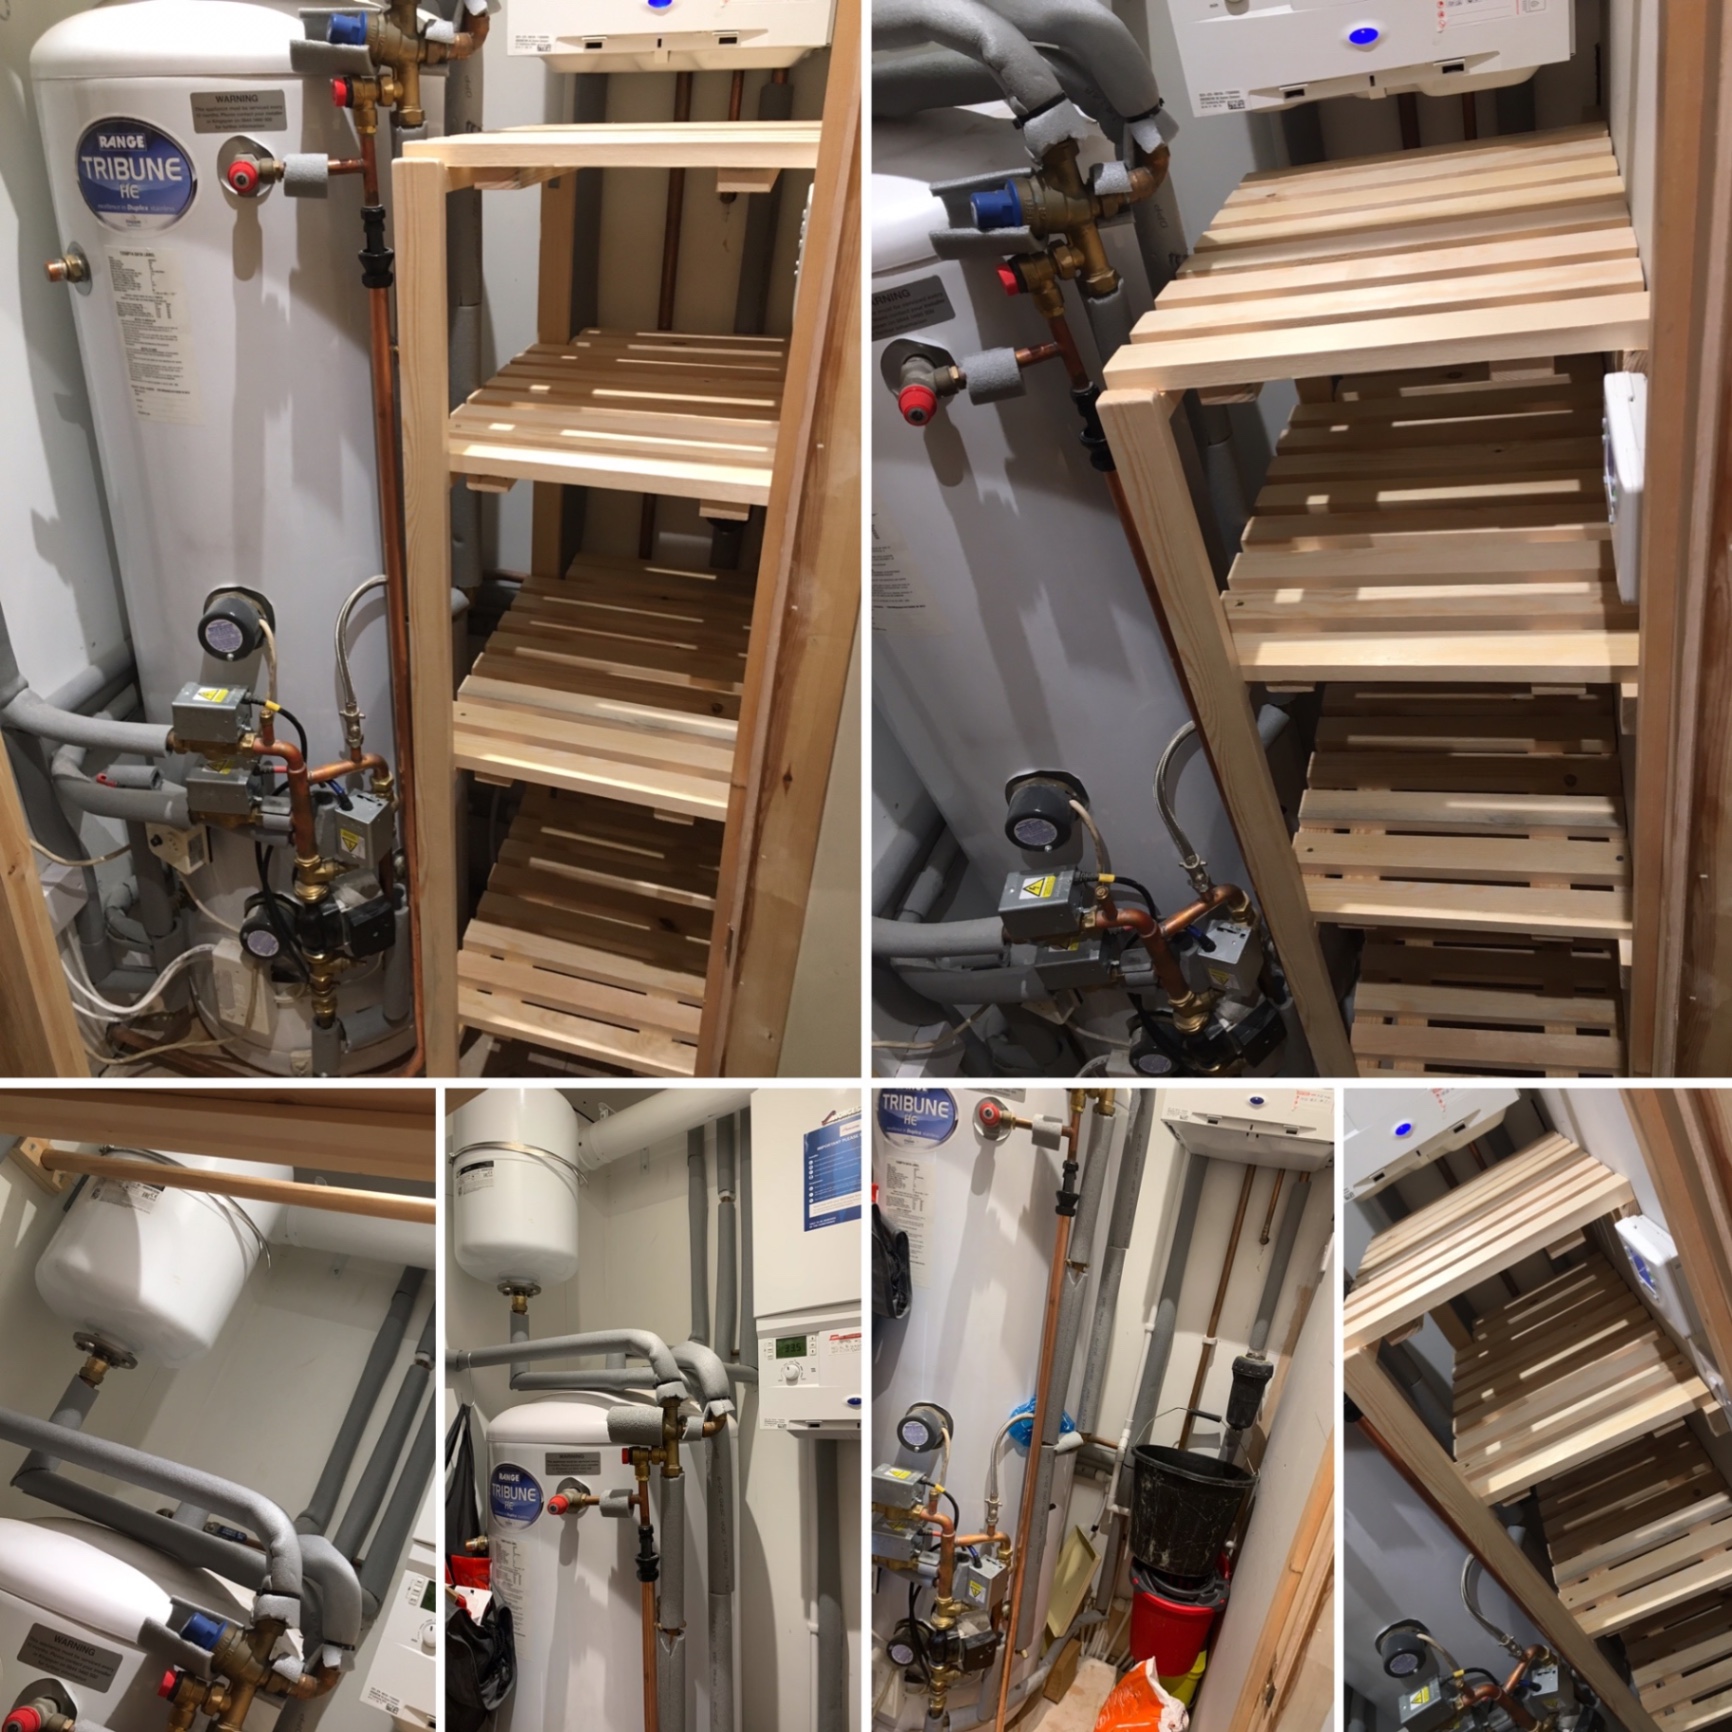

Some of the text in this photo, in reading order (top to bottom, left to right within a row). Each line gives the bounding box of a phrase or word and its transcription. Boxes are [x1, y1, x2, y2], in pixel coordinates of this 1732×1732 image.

[215, 94, 258, 104] WARNING
[99, 135, 145, 149] RANGE
[81, 156, 182, 180] TRIBUNE
[120, 184, 140, 198] HE
[882, 1094, 949, 1119] TRIBUNE
[904, 1114, 918, 1126] HE
[498, 1473, 519, 1482] RANGE
[492, 1483, 536, 1502] TRIBUNE
[504, 1502, 514, 1510] HE
[54, 1634, 96, 1656] WARNING
